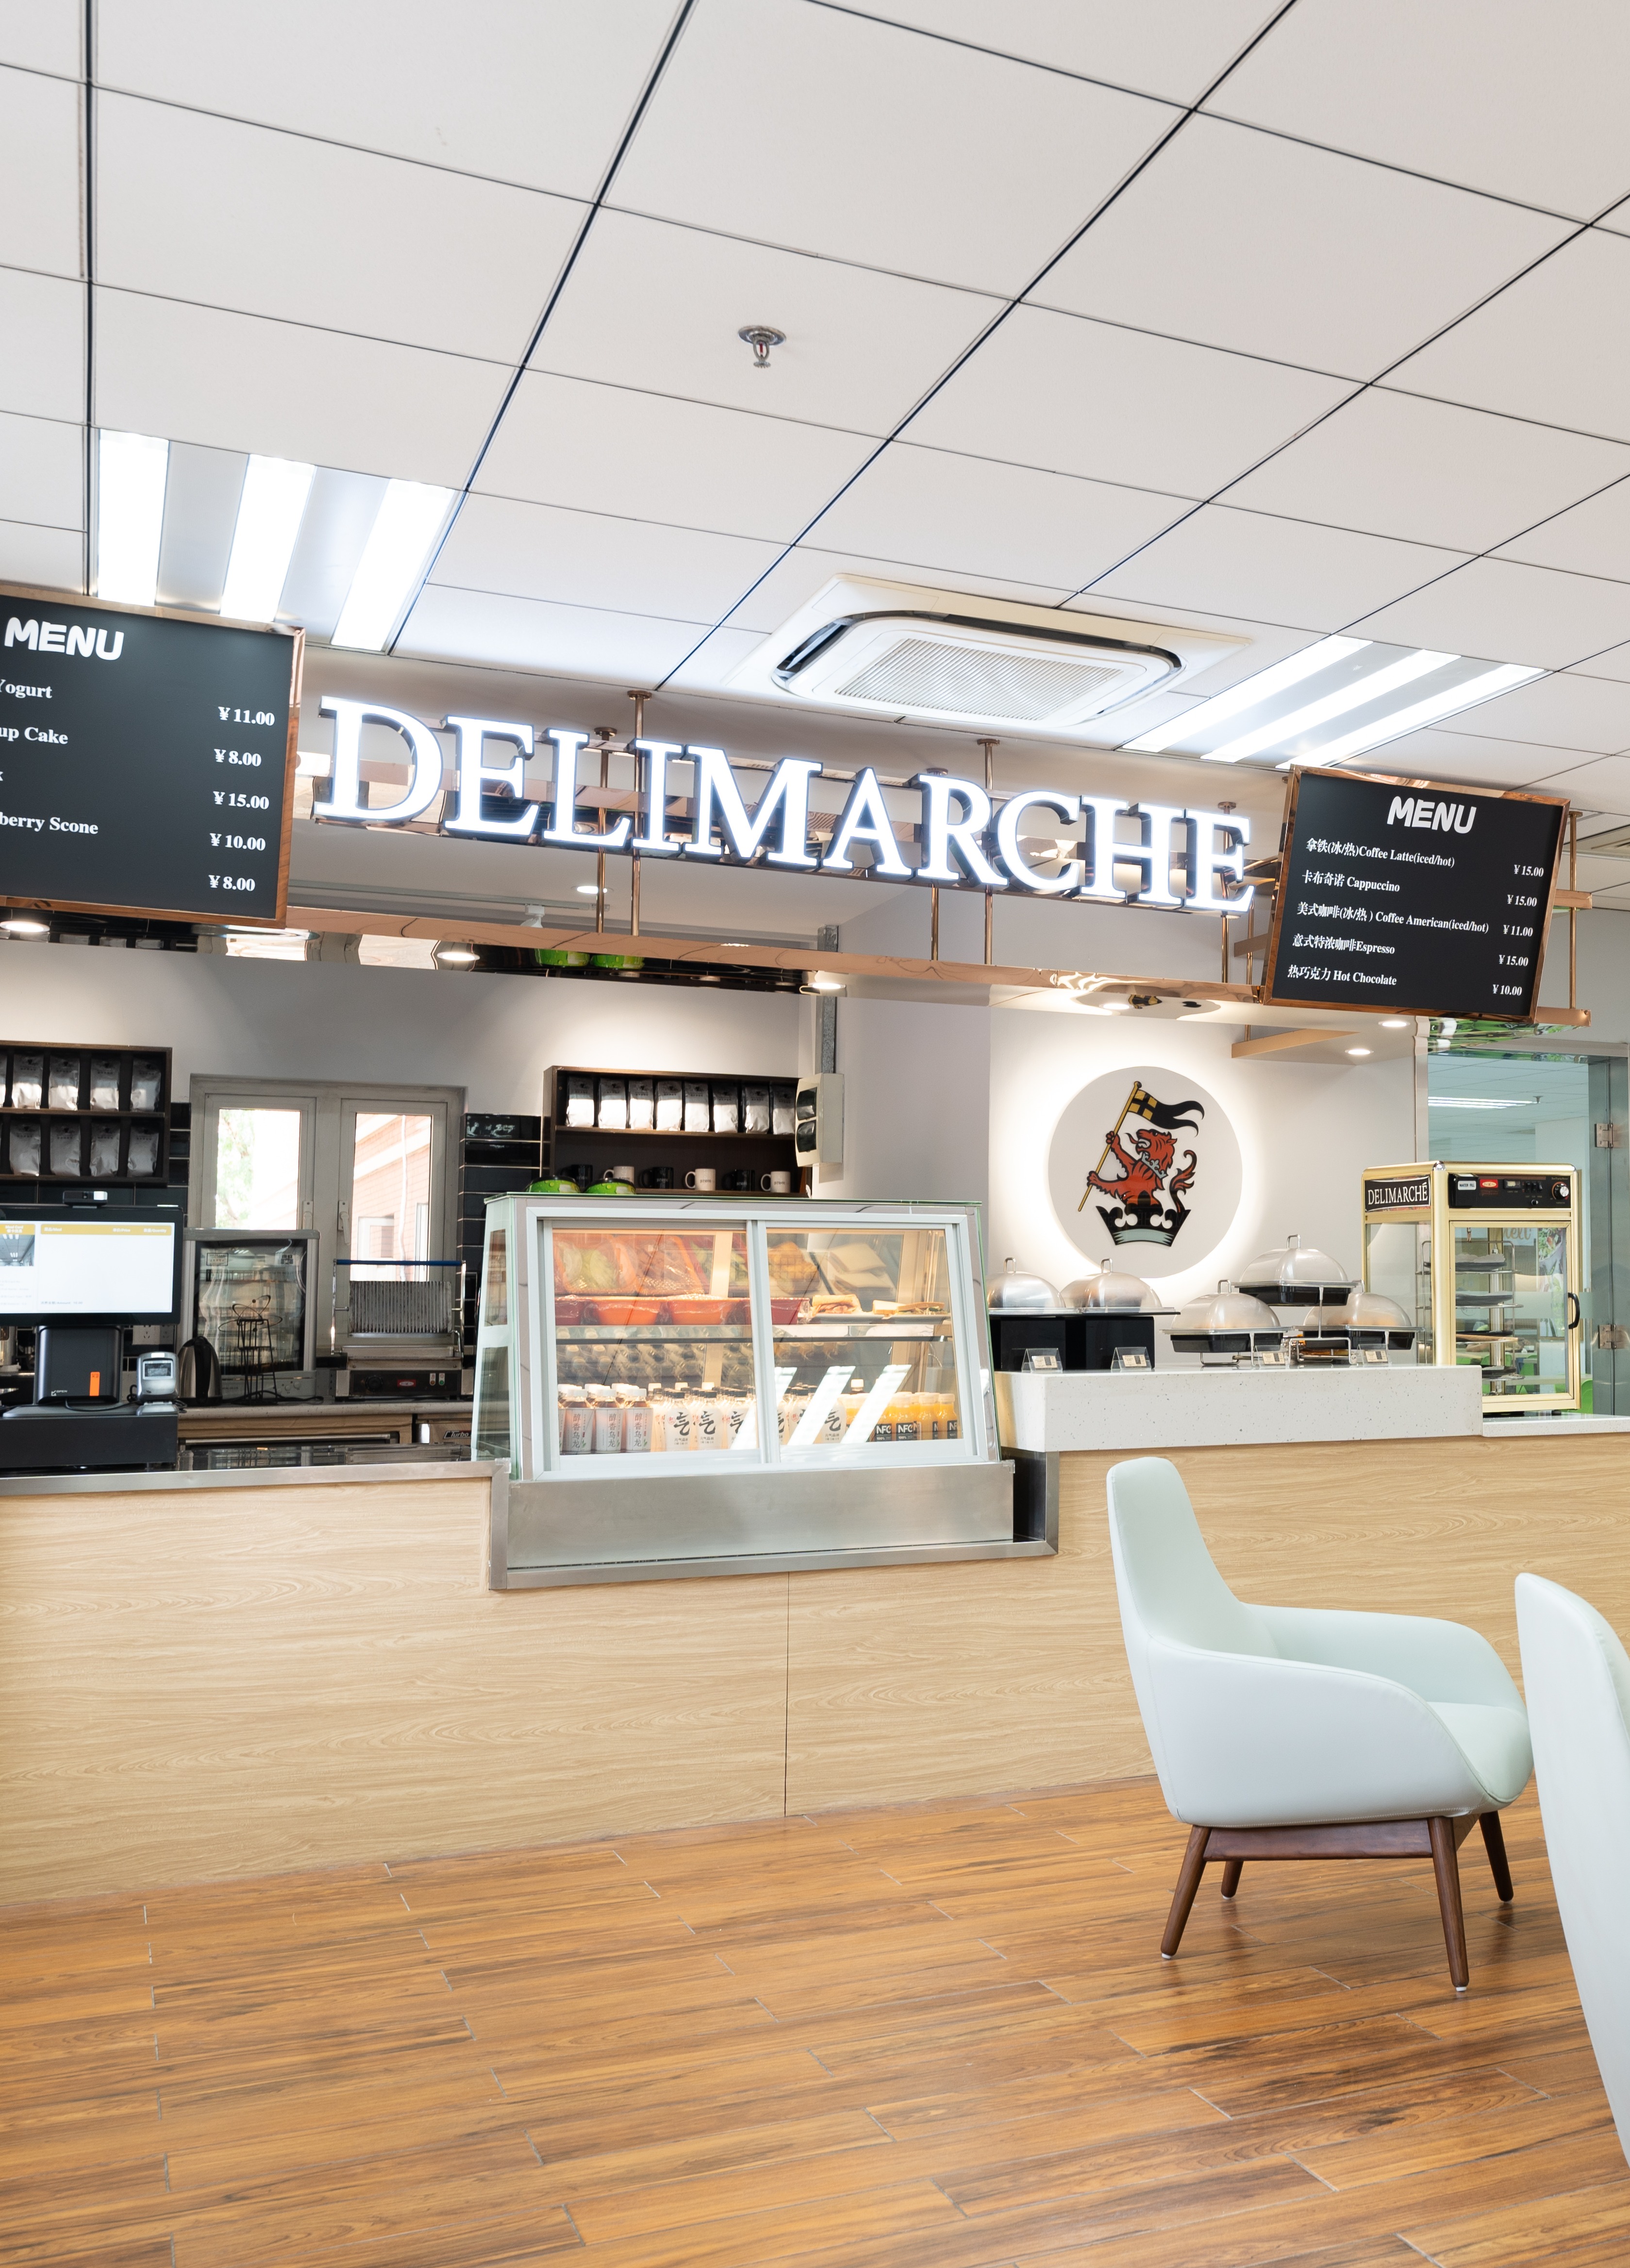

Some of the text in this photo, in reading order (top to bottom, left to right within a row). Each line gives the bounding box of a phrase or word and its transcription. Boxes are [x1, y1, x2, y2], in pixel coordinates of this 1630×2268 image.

[4, 617, 125, 661] MENU
[24, 727, 68, 745] Cake
[314, 695, 1256, 913] DELIMARCHE
[1387, 796, 1477, 834] MENU
[49, 817, 99, 834] Scone
[1390, 849, 1455, 868] Latte(iced/hot)
[1302, 869, 1345, 887] 卡布奇诺
[1347, 876, 1400, 892] Cappuccino
[1375, 911, 1404, 924] Coffee
[1287, 964, 1331, 981] 热巧克力
[1333, 970, 1351, 982] Hot
[1352, 972, 1397, 985] Chocolate
[1368, 1182, 1428, 1205] DELIMARCHÉ
[572, 1413, 582, 1448] 醇香乌龙
[608, 1413, 617, 1448] 醇香乌龙
[633, 1413, 643, 1447] 醇香乌龙
[876, 1425, 892, 1434] NFC
[898, 1424, 913, 1433] NFC
